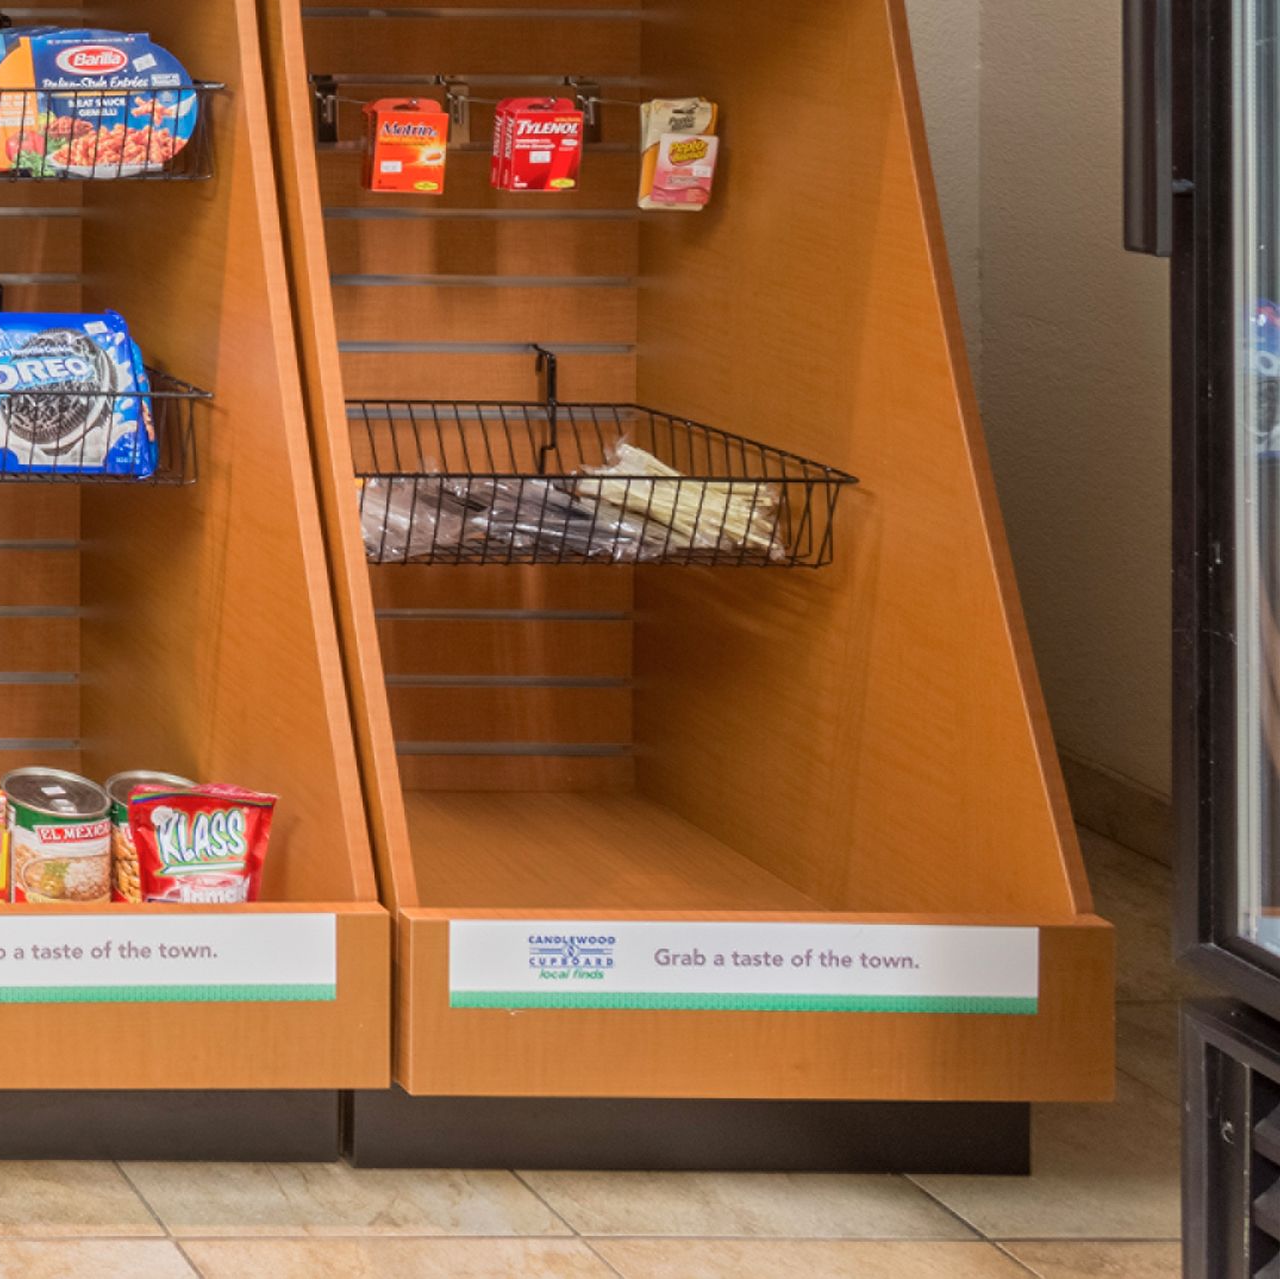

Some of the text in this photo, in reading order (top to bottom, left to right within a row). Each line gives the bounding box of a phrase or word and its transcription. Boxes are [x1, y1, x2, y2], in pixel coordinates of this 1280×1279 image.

[73, 52, 121, 66] Barilla
[516, 119, 578, 136] TYLENOL
[155, 808, 246, 863] KLASS
[528, 934, 616, 945] CANDLEWOOD
[13, 947, 25, 960] a
[31, 943, 83, 960] taste
[91, 941, 112, 959] of
[117, 941, 151, 959] the
[159, 942, 218, 959] town.
[529, 957, 615, 968] CUPBOARD
[654, 948, 920, 969] Grab a taste of the town.
[539, 967, 605, 980] local finds
